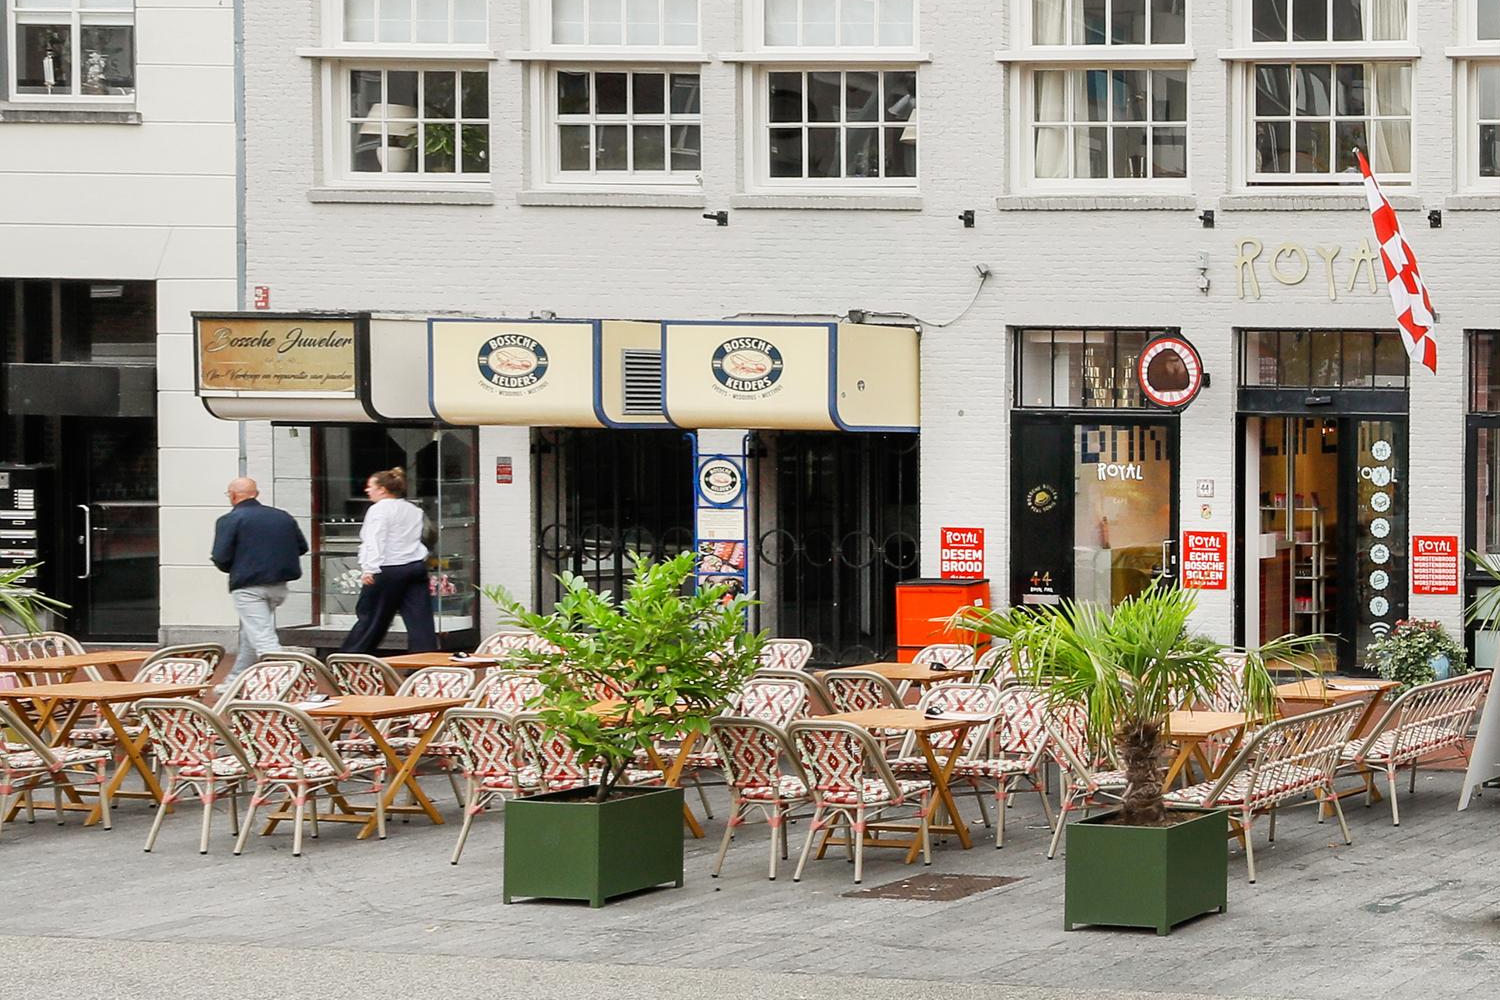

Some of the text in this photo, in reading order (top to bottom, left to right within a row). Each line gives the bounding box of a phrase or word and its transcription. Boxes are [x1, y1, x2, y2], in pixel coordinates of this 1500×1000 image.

[1234, 236, 1378, 301] ROYA
[206, 327, 352, 353] Bossche Juwelier
[489, 335, 537, 350] BOSSCHE
[723, 338, 772, 354] BOSSCHE
[491, 373, 537, 387] KELDERS
[725, 376, 772, 391] KELDERS
[1097, 463, 1143, 481] ROYAL
[946, 531, 979, 544] ROYAL
[1188, 535, 1221, 548] ROYAL
[1418, 539, 1452, 552] ROYAL
[942, 549, 982, 560] DESEM
[1189, 552, 1220, 561] ECHTE
[942, 561, 982, 572] BROOD
[1185, 561, 1224, 570] BOSSCHE
[1030, 571, 1052, 586] 44
